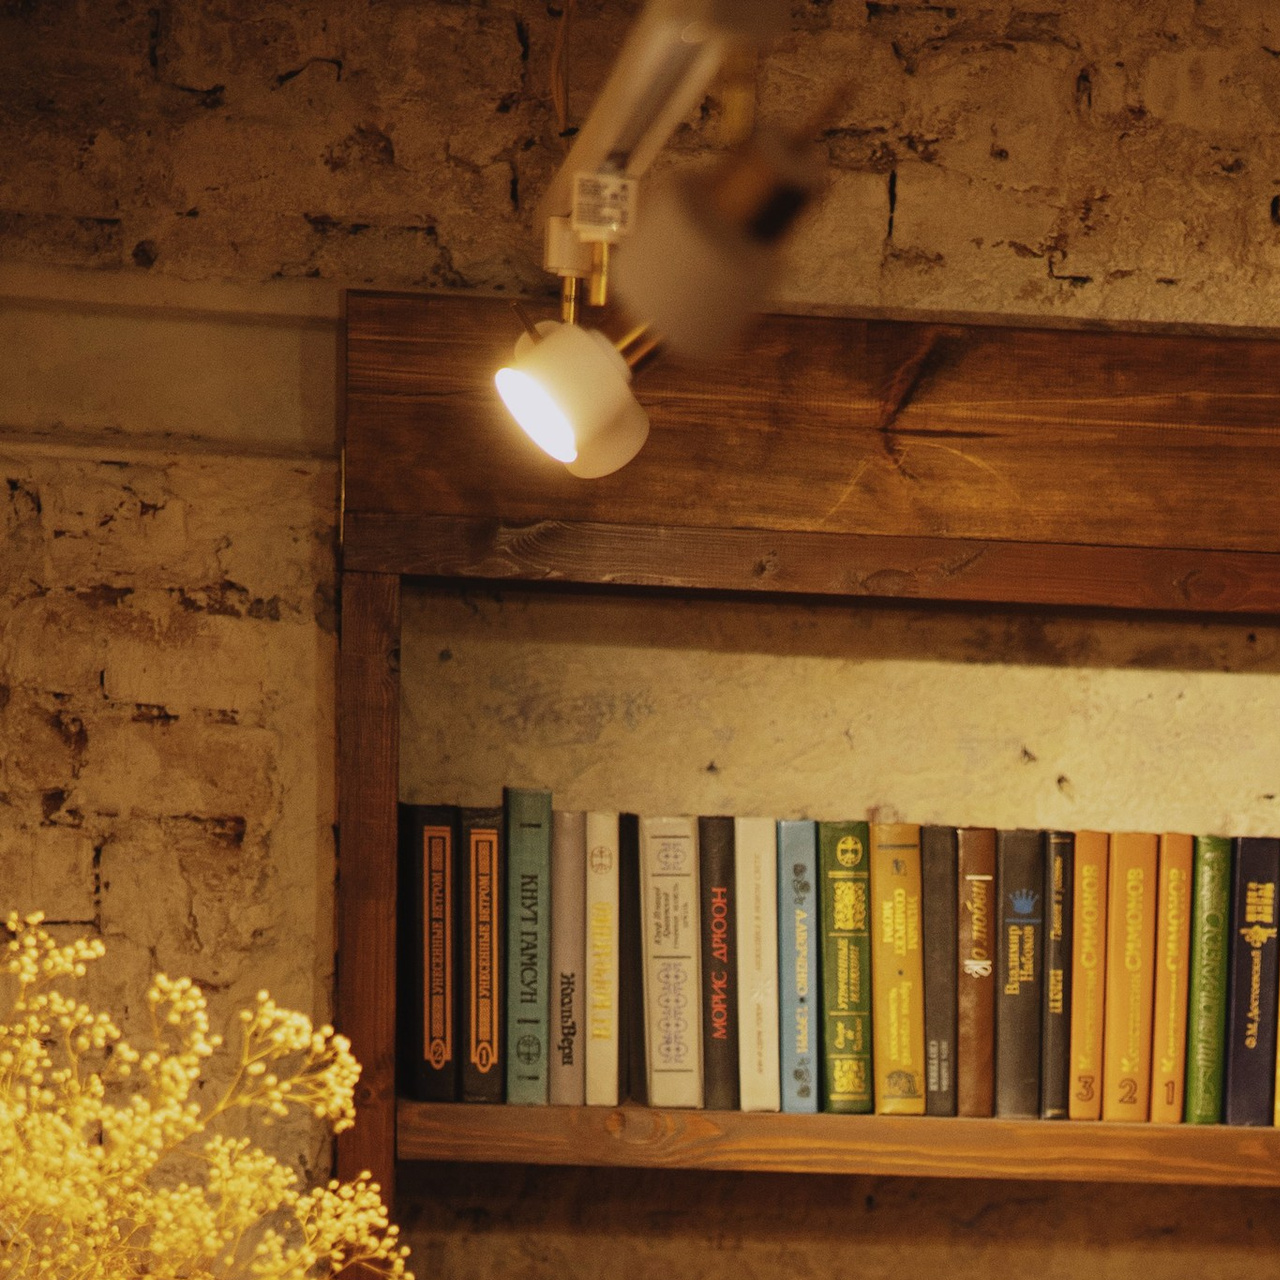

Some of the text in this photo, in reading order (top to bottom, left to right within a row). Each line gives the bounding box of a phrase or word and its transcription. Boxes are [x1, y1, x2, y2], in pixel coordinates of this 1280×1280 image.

[432, 871, 444, 995] УНЕСЕННЫЕ ВЕТРОМ
[479, 874, 491, 997] УНЕСЕННЫЕ ВЕТРОМ
[519, 873, 540, 1005] КНУТ ГАМСУН
[882, 900, 894, 943] МОЭМ
[894, 889, 907, 956] СОМЕРСЕТ
[1020, 925, 1035, 981] Набоков
[1080, 865, 1099, 968] СИМОНОВ
[1124, 867, 1144, 971] СИМОНОВ
[1165, 867, 1185, 971] СИМОНОВ
[711, 886, 728, 1039] МОРИС ДРЮОН
[1004, 925, 1023, 995] Владимир
[433, 1046, 443, 1061] 2
[557, 972, 577, 1066] Жюль Верн
[1077, 1075, 1095, 1102] 3
[1118, 1078, 1138, 1104] 2
[1164, 1080, 1175, 1105] 1
